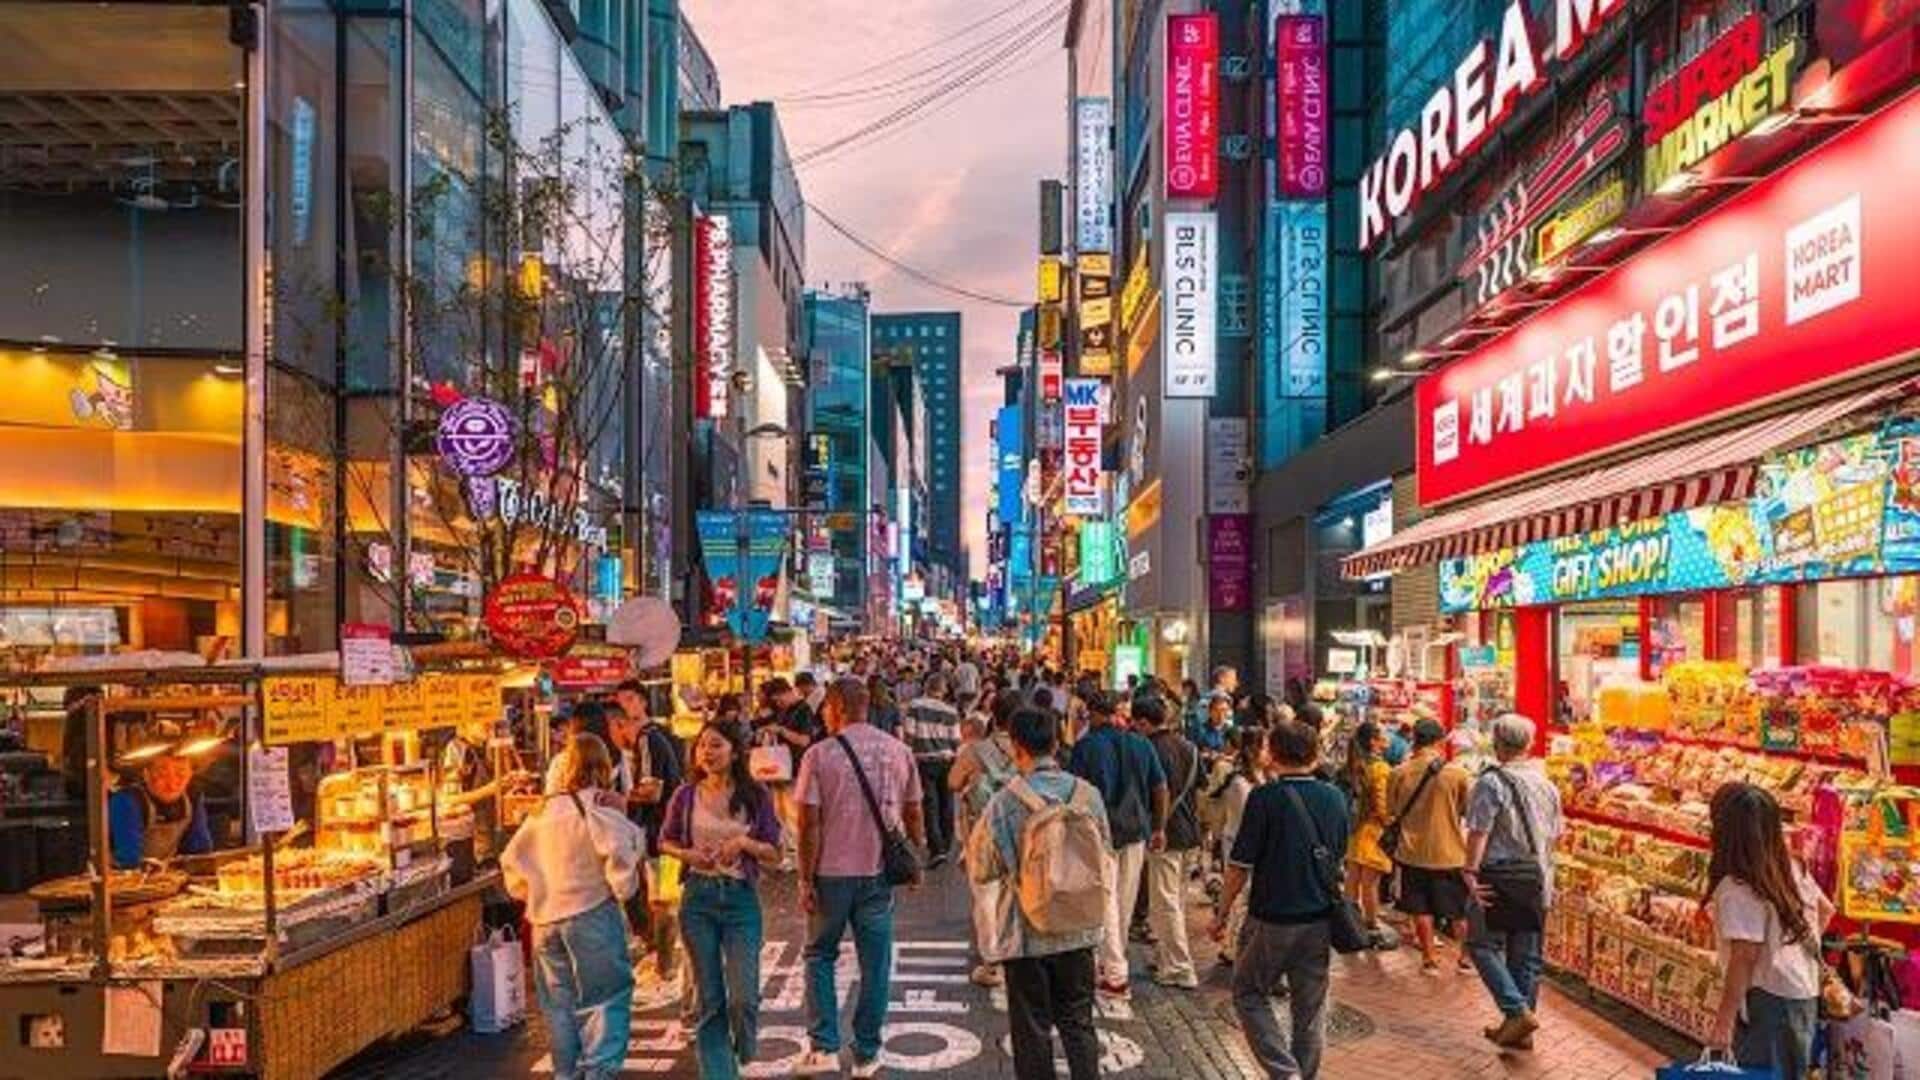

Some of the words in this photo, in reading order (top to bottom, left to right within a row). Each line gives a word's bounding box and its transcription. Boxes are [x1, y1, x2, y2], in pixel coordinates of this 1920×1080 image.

[1175, 56, 1192, 119] CLINIC
[1645, 38, 1796, 192] MARKET
[1359, 0, 1540, 250] KOREA
[1176, 226, 1195, 270] BLS
[1792, 256, 1854, 303] MART
[1176, 275, 1195, 354] CLINIC
[1067, 383, 1098, 405] MK
[1067, 407, 1099, 496] 부동산
[1553, 552, 1592, 597] GIFT
[1599, 532, 1672, 589] SHOP!
